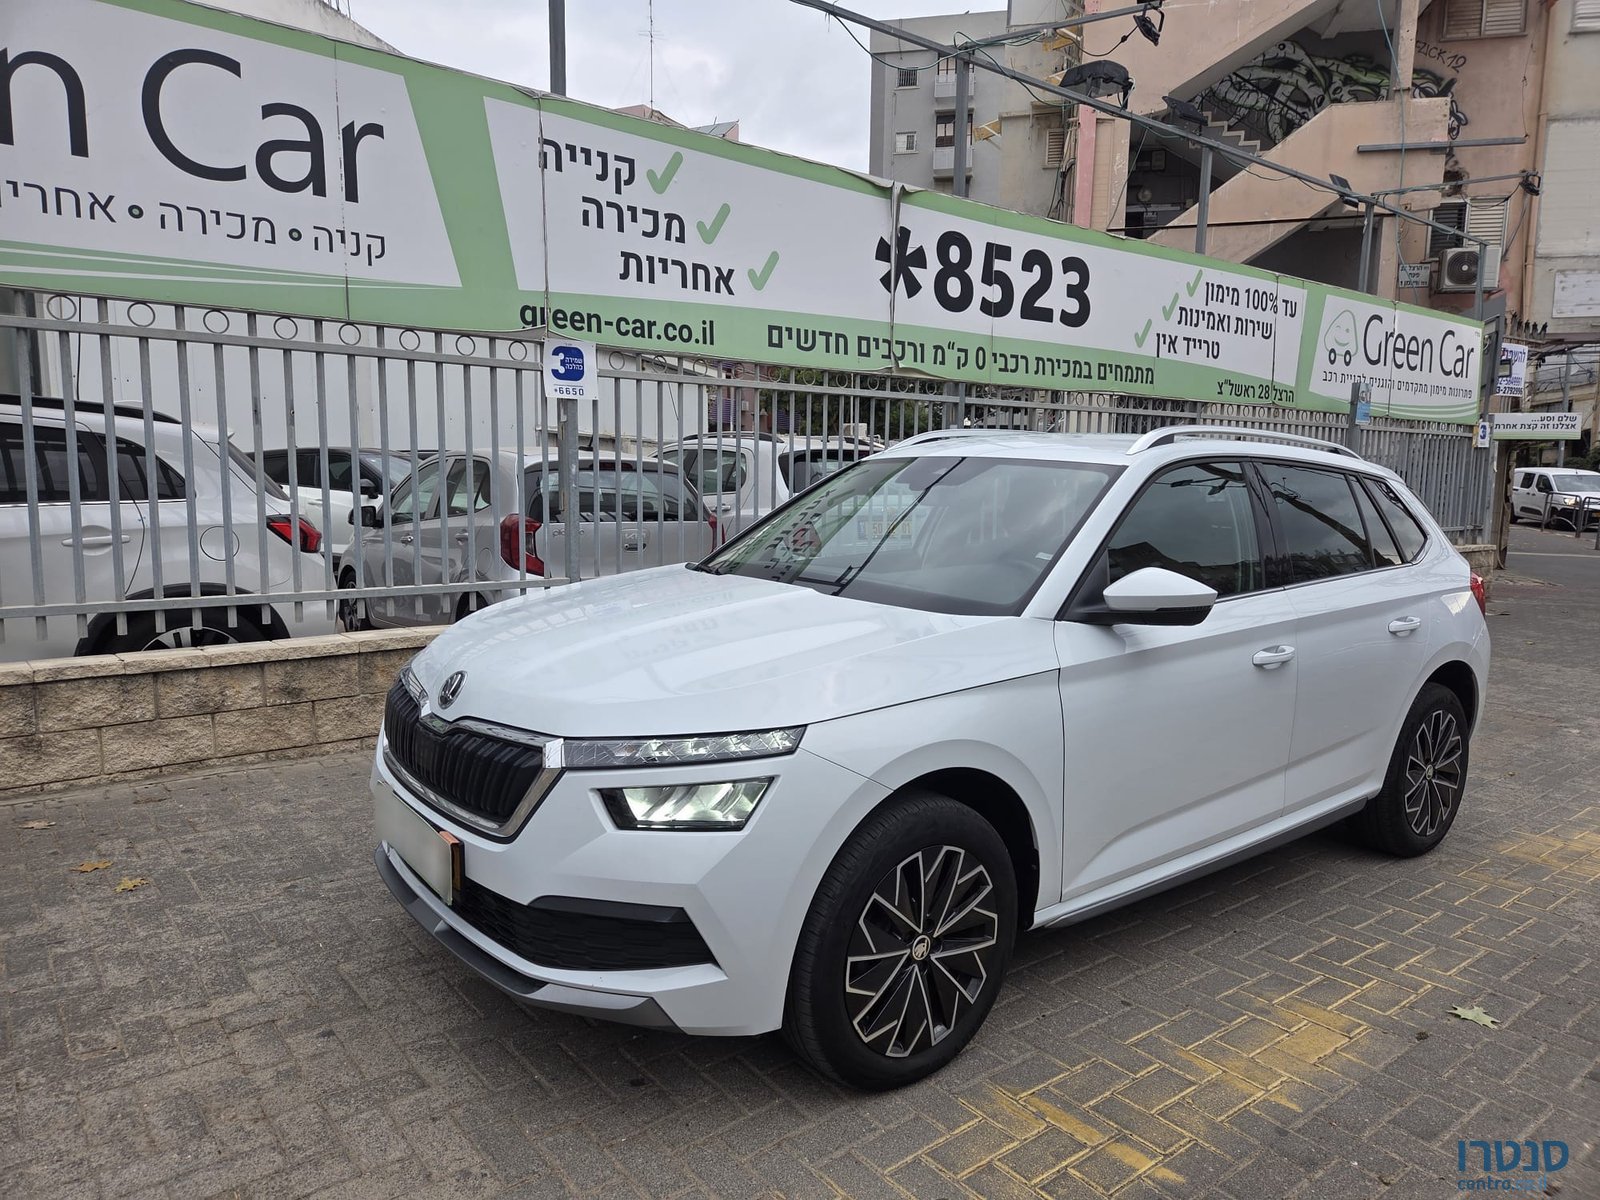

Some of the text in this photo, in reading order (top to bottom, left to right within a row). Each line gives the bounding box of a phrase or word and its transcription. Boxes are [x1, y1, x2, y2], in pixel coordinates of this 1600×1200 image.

[142, 48, 385, 203] Car
[538, 137, 635, 195] קנייה
[160, 203, 276, 244] מכירה
[582, 195, 686, 244] מכירה
[313, 226, 386, 266] קניה
[620, 250, 735, 296] אחריות
[1205, 282, 1298, 318] עד 100% מימון
[519, 304, 715, 346] green-car.co.il
[1177, 306, 1273, 340] שירות ואמינות
[768, 324, 849, 356] חדשים
[858, 335, 925, 363] ורכבים
[1156, 332, 1220, 359] טרייד אין
[1363, 314, 1475, 379] Green Car
[975, 346, 987, 370] 0
[992, 352, 1029, 374] רכבי
[1034, 356, 1092, 379] במכירת
[1098, 362, 1155, 385] מתמחים
[1322, 370, 1338, 382] רכב
[1257, 384, 1270, 399] 28
[1273, 384, 1295, 403] הרצל
[1520, 423, 1538, 431] קצת
[1552, 422, 1577, 430] אצלנו
[1557, 414, 1578, 422] שלם
